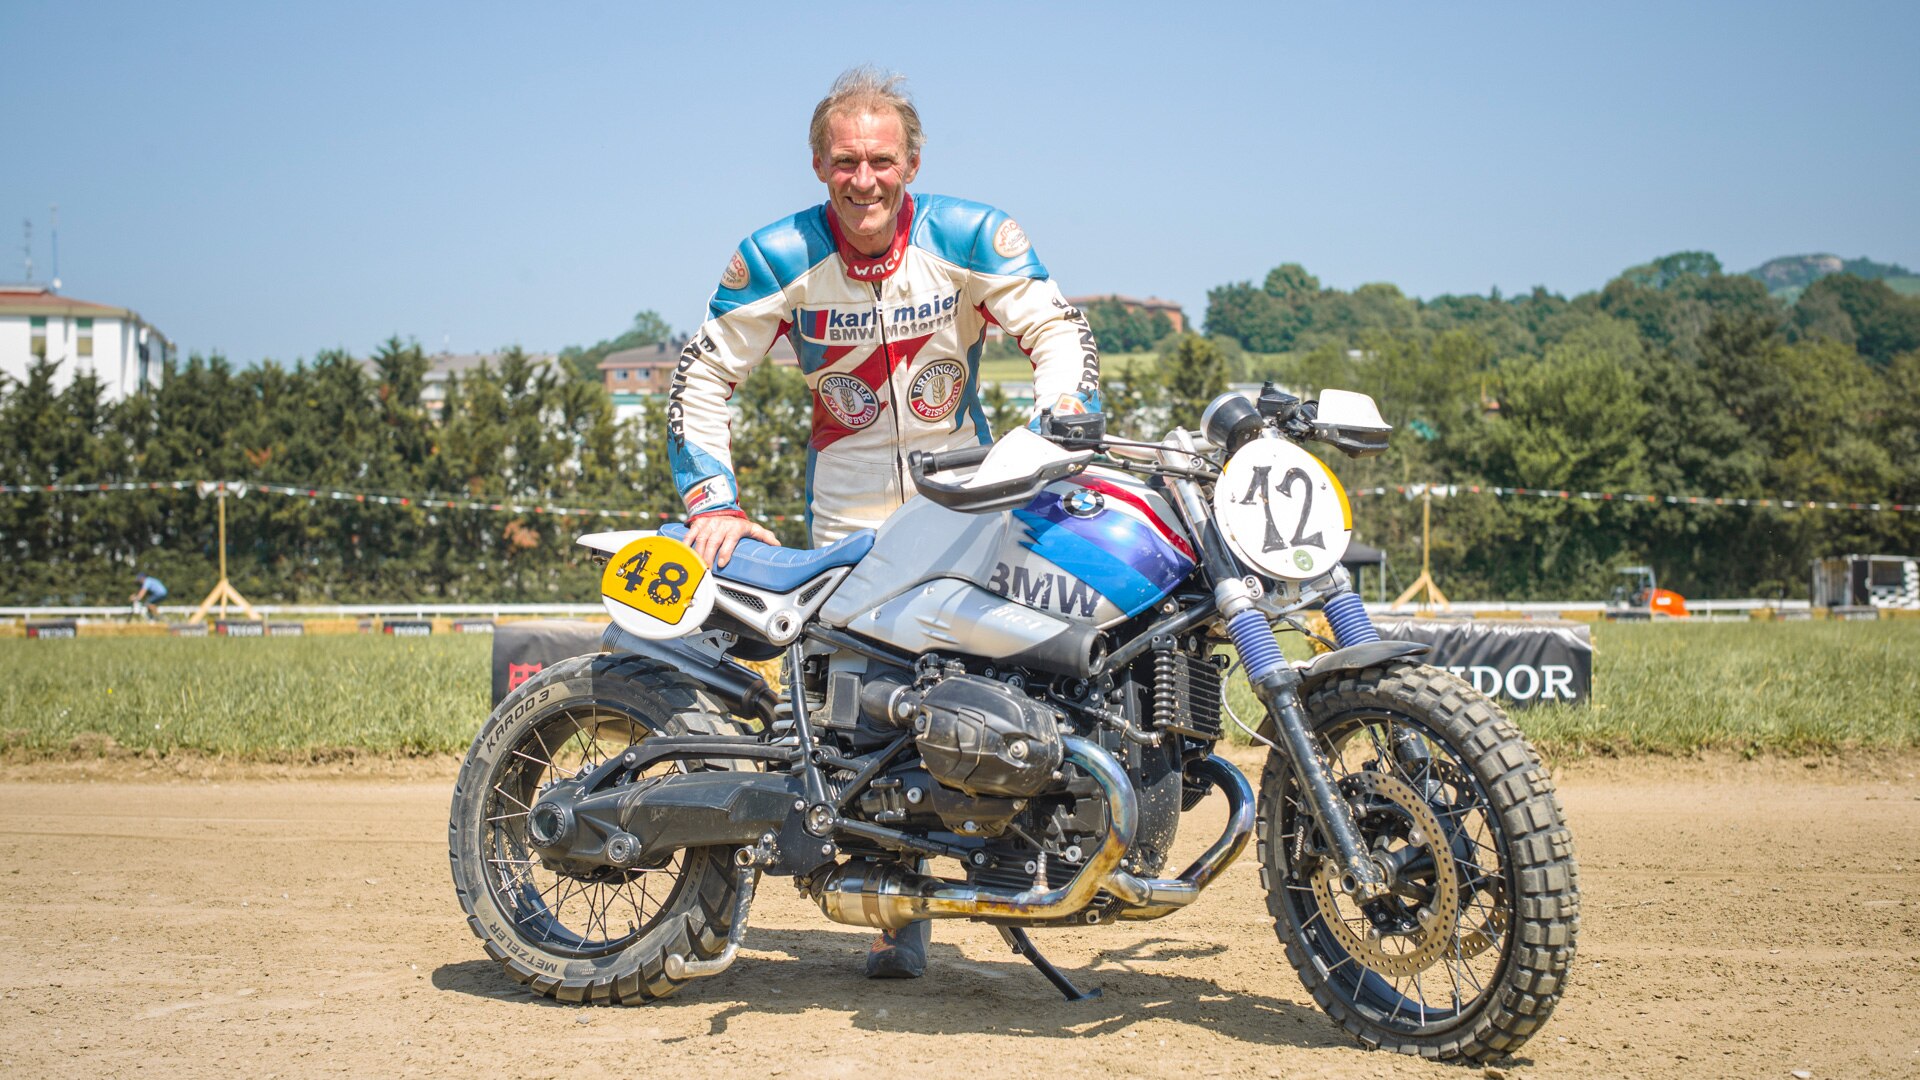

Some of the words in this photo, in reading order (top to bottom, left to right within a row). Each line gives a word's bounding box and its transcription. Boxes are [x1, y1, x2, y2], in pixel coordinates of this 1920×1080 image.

[853, 249, 900, 276] WACO
[829, 306, 878, 328] karl
[893, 288, 961, 323] maier
[829, 326, 876, 341] BMW
[885, 305, 958, 339] Motorrad
[669, 335, 717, 455] ERDINGER
[823, 377, 872, 402] ERDINGER
[913, 364, 961, 394] ERDINGER
[1238, 465, 1327, 554] 12
[615, 549, 689, 607] 48
[988, 561, 1104, 618] BMW
[1433, 664, 1577, 700] DOR
[486, 697, 535, 753] KAROO
[538, 689, 550, 703] 3
[1292, 825, 1305, 861] brembo
[489, 921, 559, 974] METZELER
